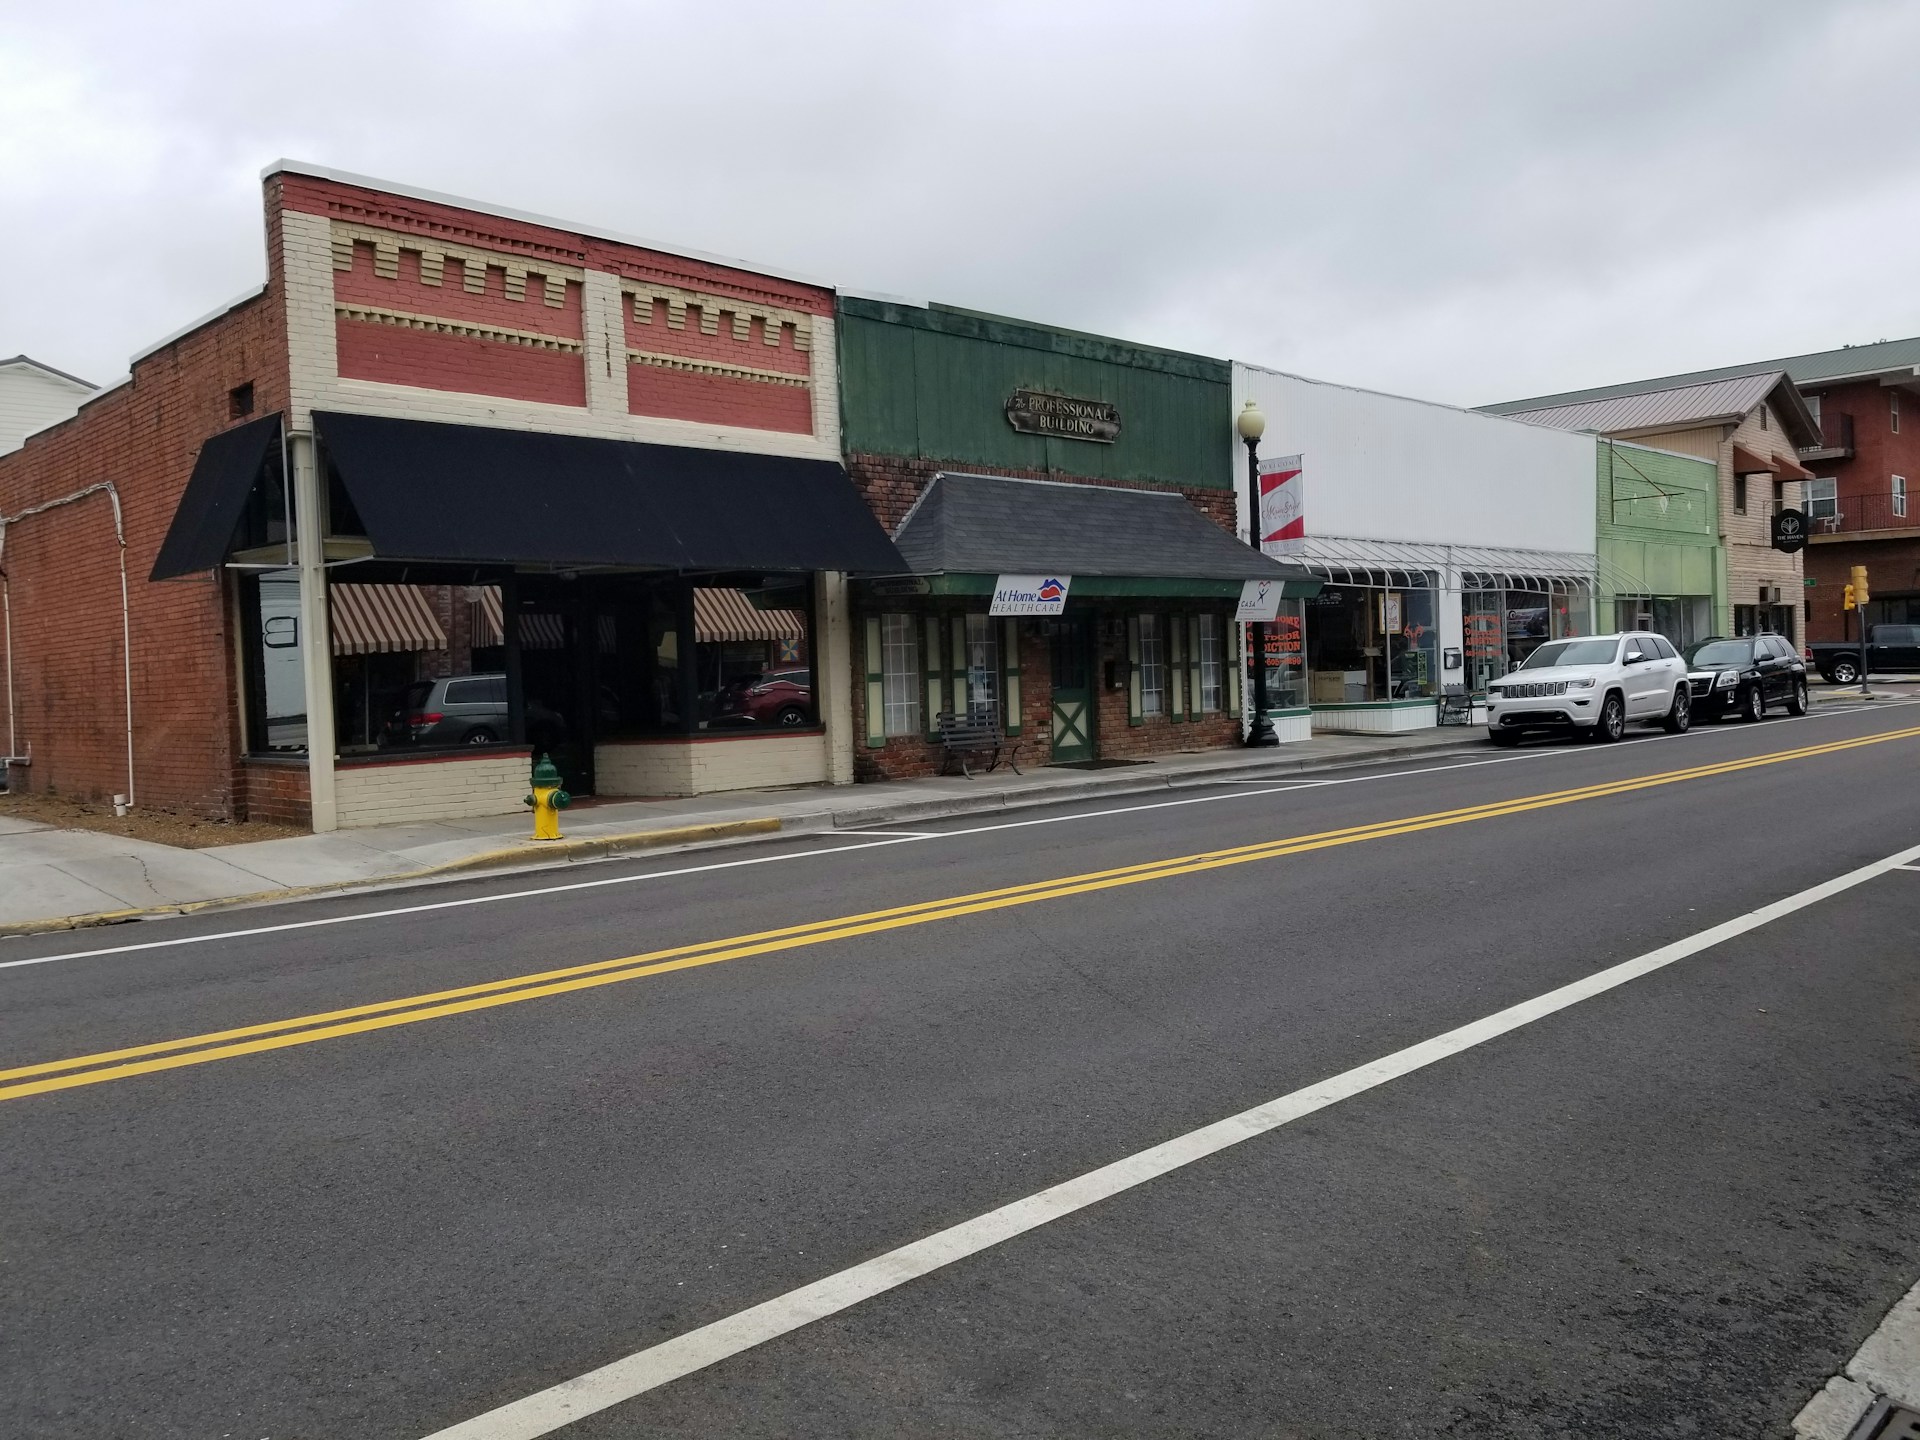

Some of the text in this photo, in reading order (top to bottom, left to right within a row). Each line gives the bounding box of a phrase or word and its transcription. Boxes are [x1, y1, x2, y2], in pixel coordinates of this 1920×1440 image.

[1028, 397, 1111, 421] PROFESSIONAL
[1039, 415, 1094, 434] BUILDING
[995, 590, 1037, 602] At Home
[991, 603, 1062, 613] HEALTHCARE
[1247, 631, 1300, 642] OTDOOR
